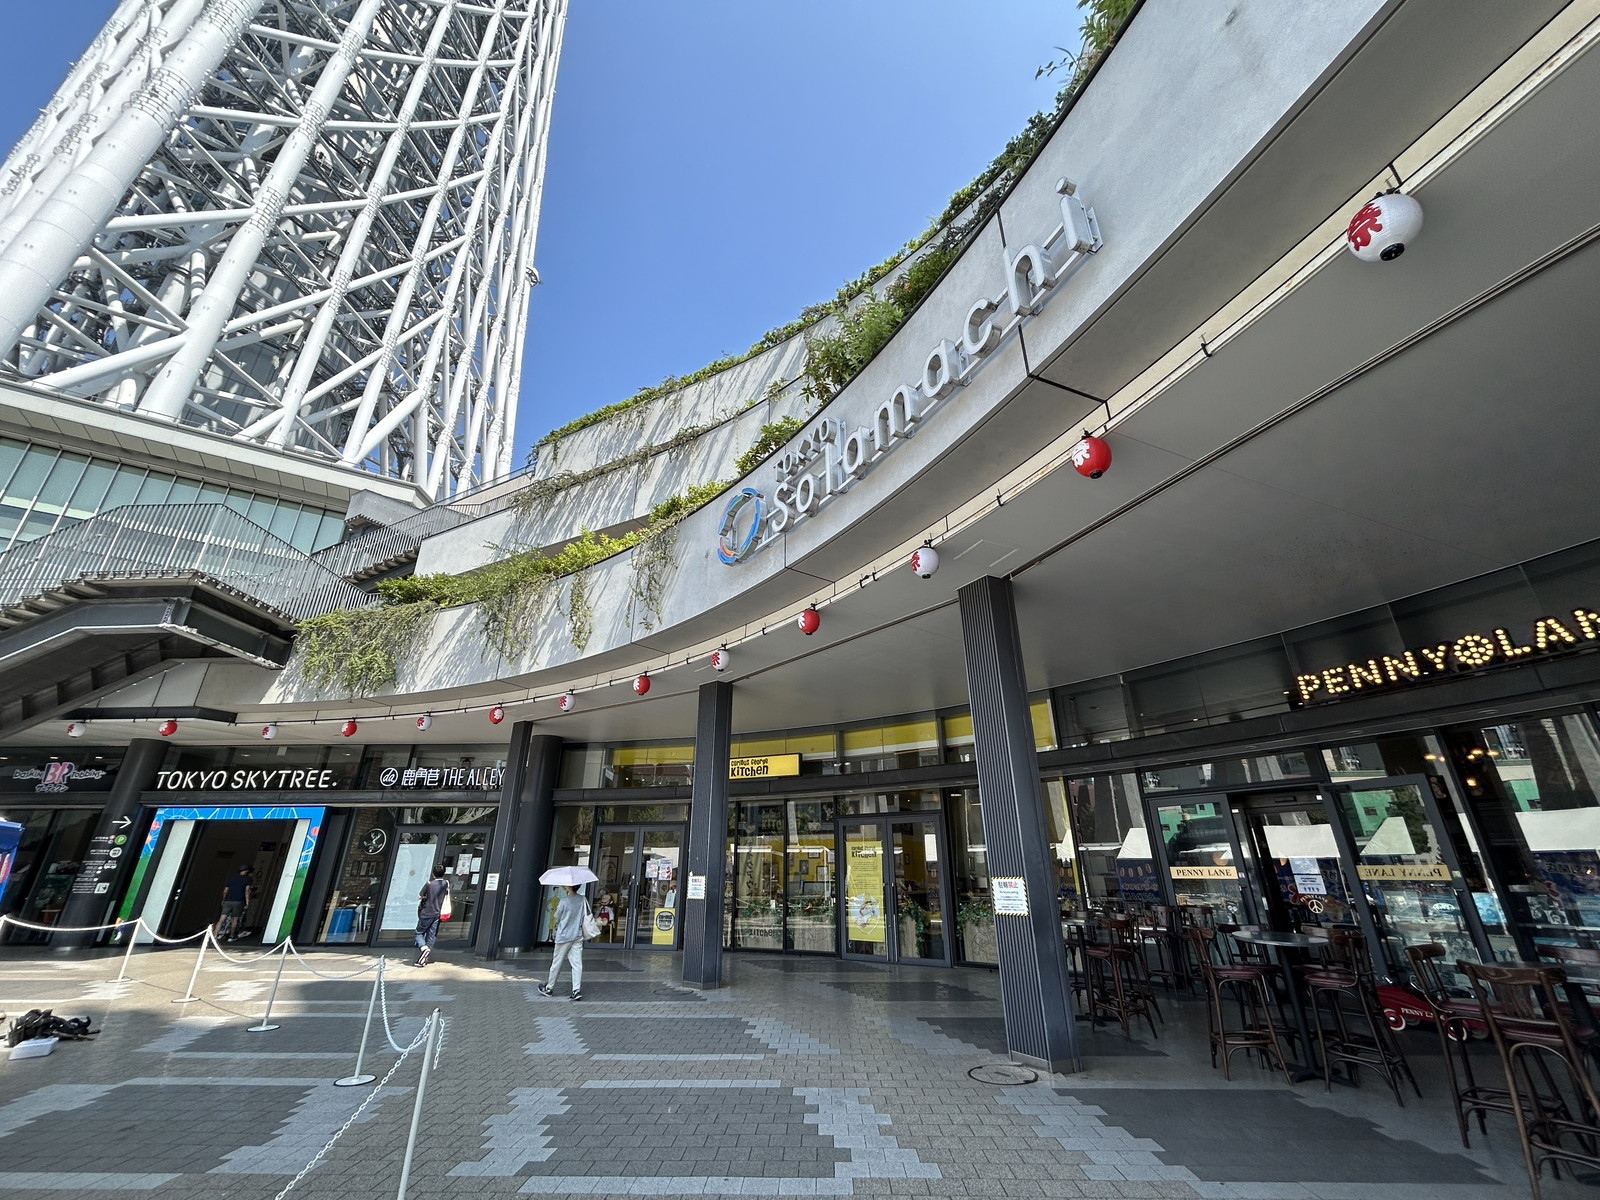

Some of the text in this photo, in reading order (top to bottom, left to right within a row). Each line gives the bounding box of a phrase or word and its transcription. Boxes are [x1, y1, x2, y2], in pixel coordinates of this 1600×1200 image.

[771, 176, 1100, 533] solamachi
[773, 417, 838, 483] TOKYO
[1297, 644, 1447, 700] PENNY
[157, 771, 228, 789] TOKYO
[442, 768, 506, 786] THE ALLEY
